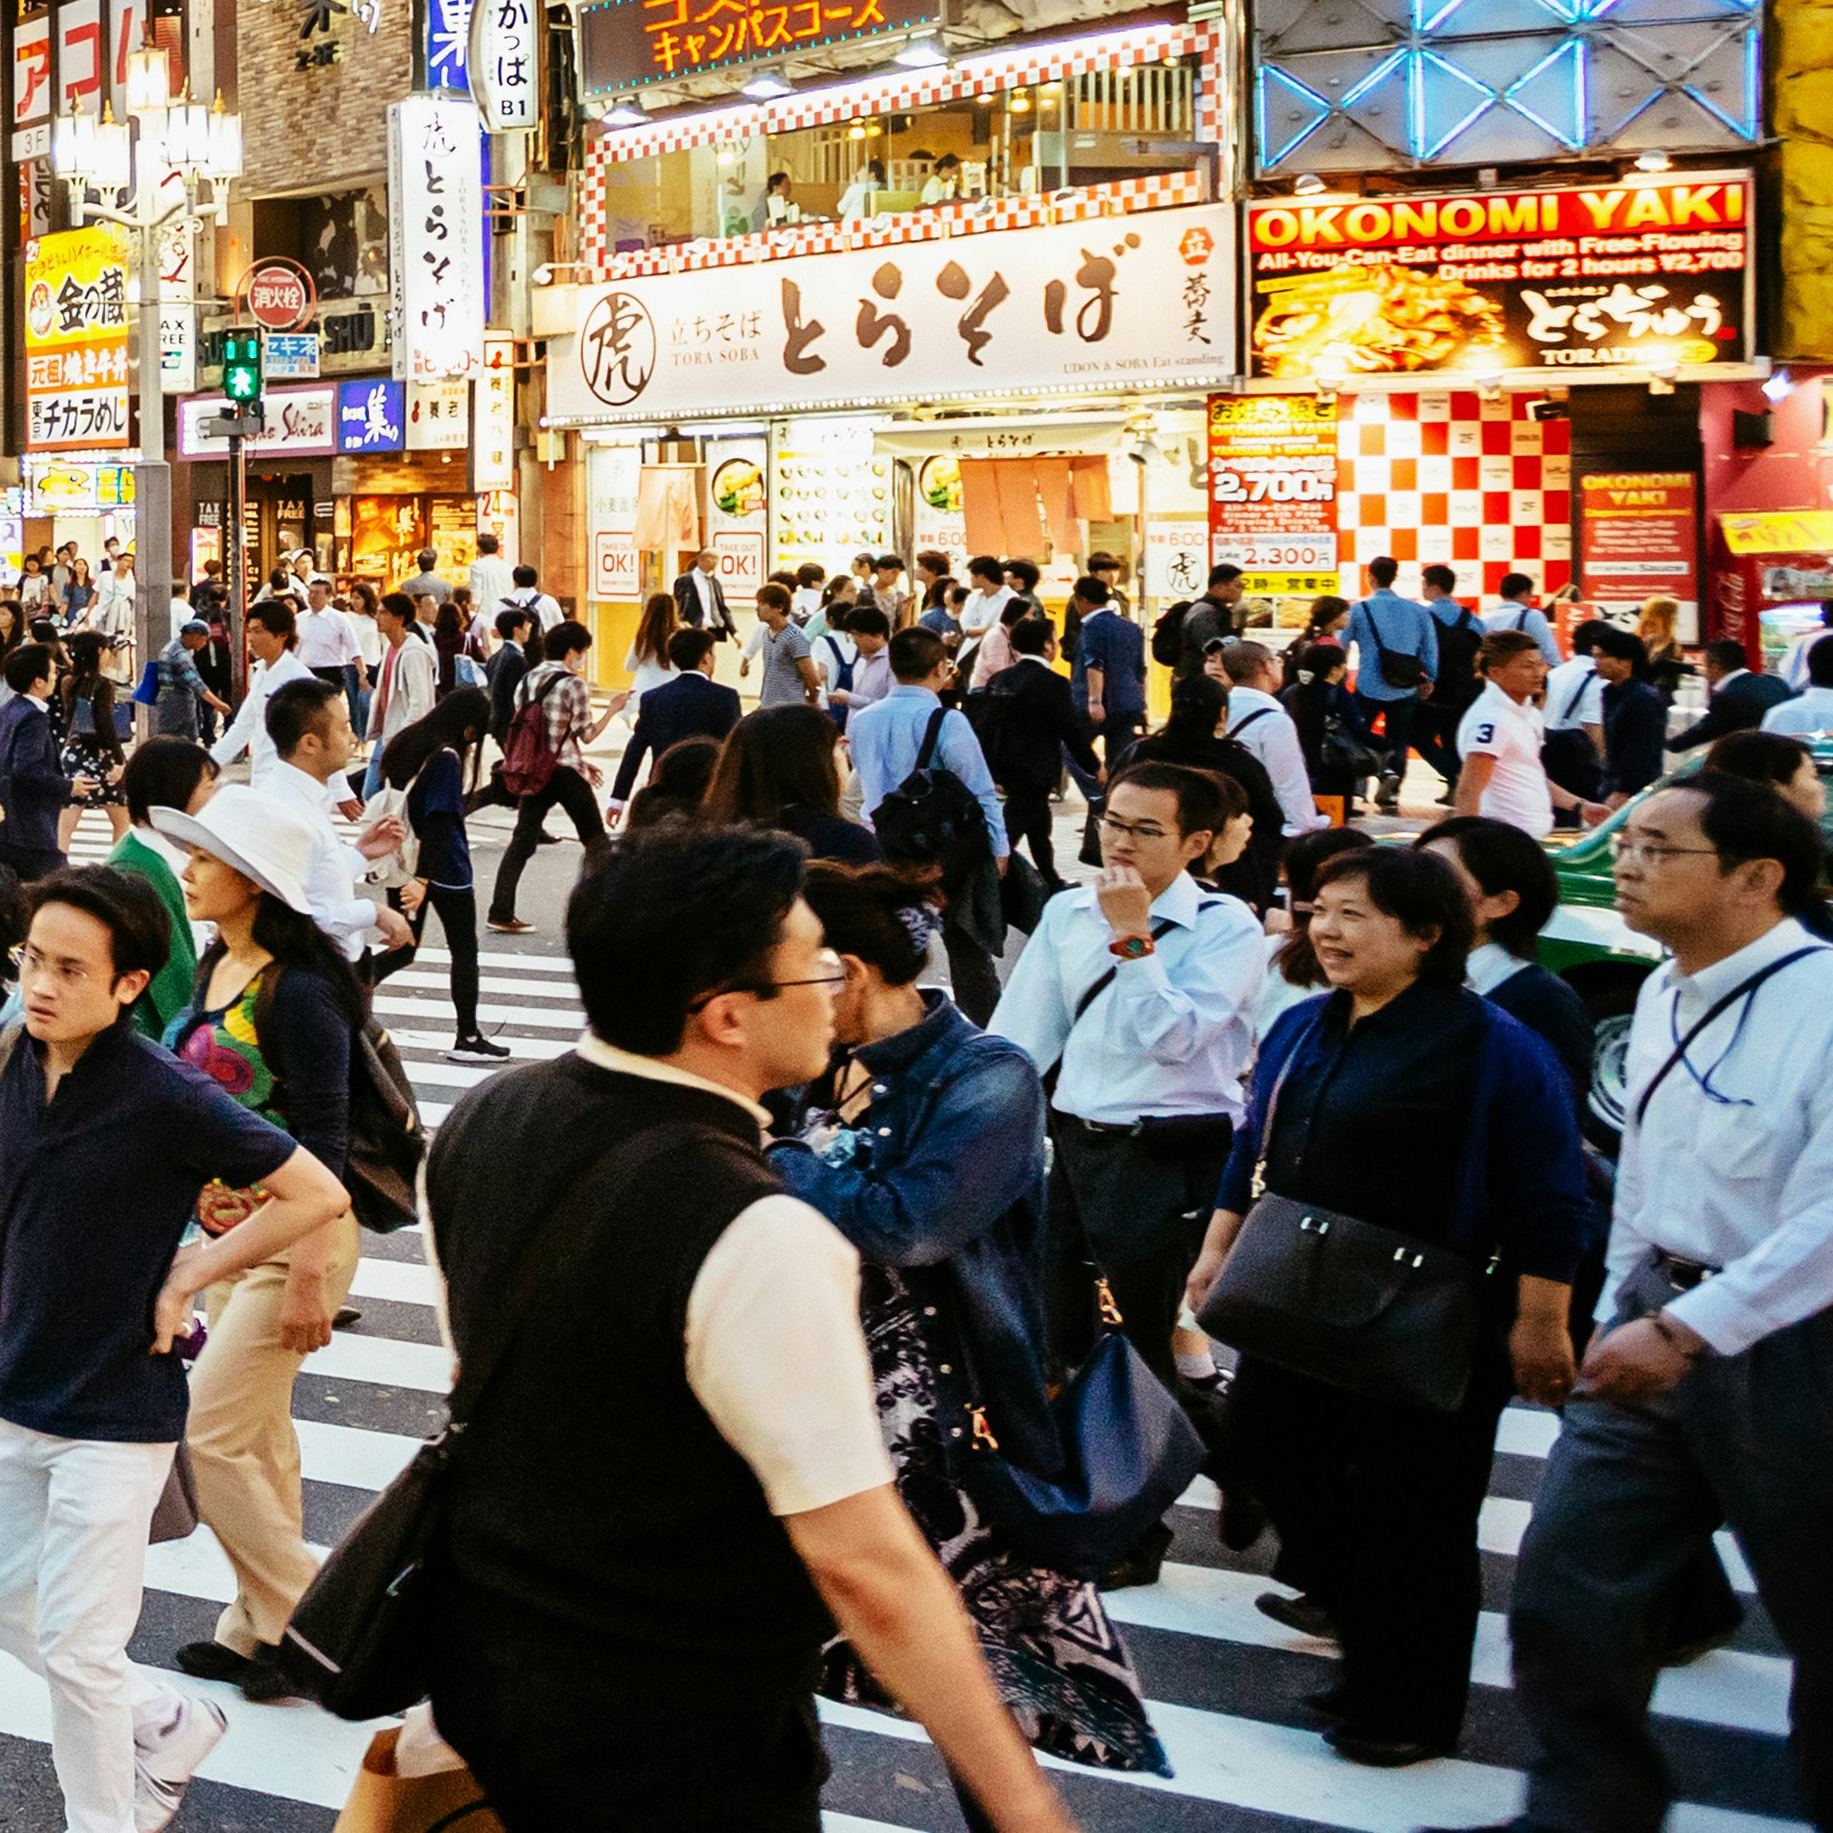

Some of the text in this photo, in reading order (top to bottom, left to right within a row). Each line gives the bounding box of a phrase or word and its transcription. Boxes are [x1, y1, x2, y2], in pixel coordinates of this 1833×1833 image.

[499, 97, 527, 117] B1
[24, 130, 44, 154] 3F
[1253, 183, 1745, 248] OKONOMI YAKI
[1257, 231, 1745, 272] All-You-Can-Eat dinner with Free-Flowing
[1439, 250, 1745, 283] Drinks for 2 hours ¥2,700
[56, 268, 125, 333] 金の蔵
[253, 285, 302, 310] 消火栓
[780, 232, 1143, 377] とらそば
[1181, 272, 1213, 347] 蕎麦
[160, 318, 185, 332] AX
[668, 312, 763, 347] 立ちそば
[160, 332, 187, 346] REE
[669, 348, 761, 367] TORA SOBA
[1063, 353, 1226, 376] UDON SOBA Eat standing
[42, 394, 127, 438] チカラめし
[1213, 470, 1334, 503] 2,700円
[1582, 473, 1693, 491] OKONOMI
[1608, 490, 1668, 505] YAKI
[601, 553, 636, 576] OK!
[721, 553, 757, 577] OK!
[1286, 578, 1336, 592] 営業中
